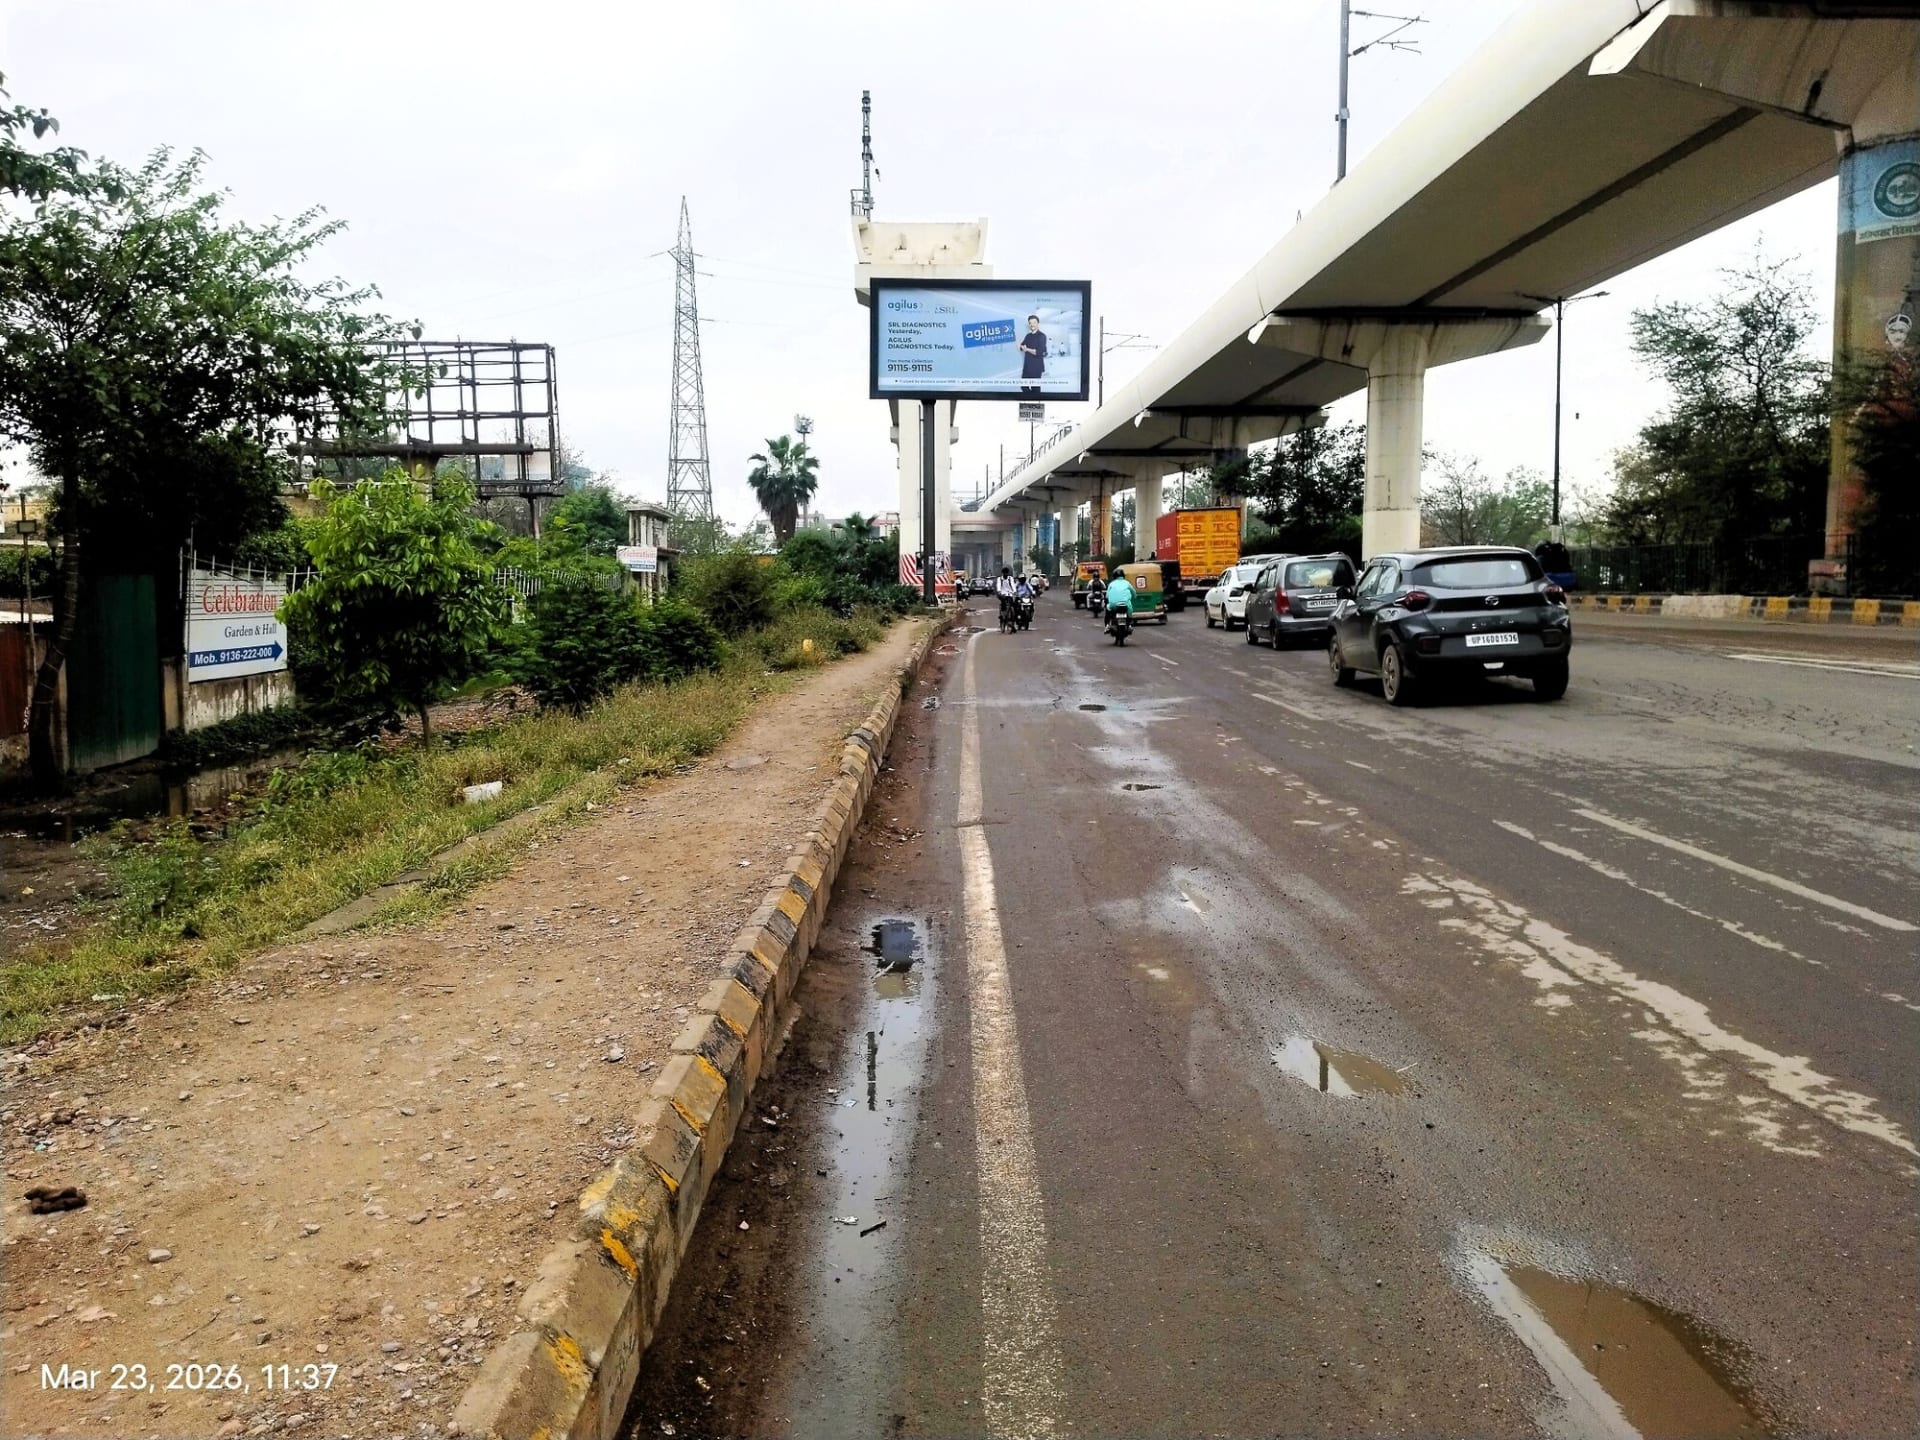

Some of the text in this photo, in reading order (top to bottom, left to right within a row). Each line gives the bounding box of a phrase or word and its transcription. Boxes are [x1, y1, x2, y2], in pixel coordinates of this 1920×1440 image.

[888, 299, 918, 311] agilus
[966, 324, 1000, 340] agilus
[888, 364, 933, 372] 91115-91115
[203, 585, 277, 613] Celebration
[224, 623, 277, 638] Garden & Hall
[195, 647, 272, 664] Mob. 9136-222-000
